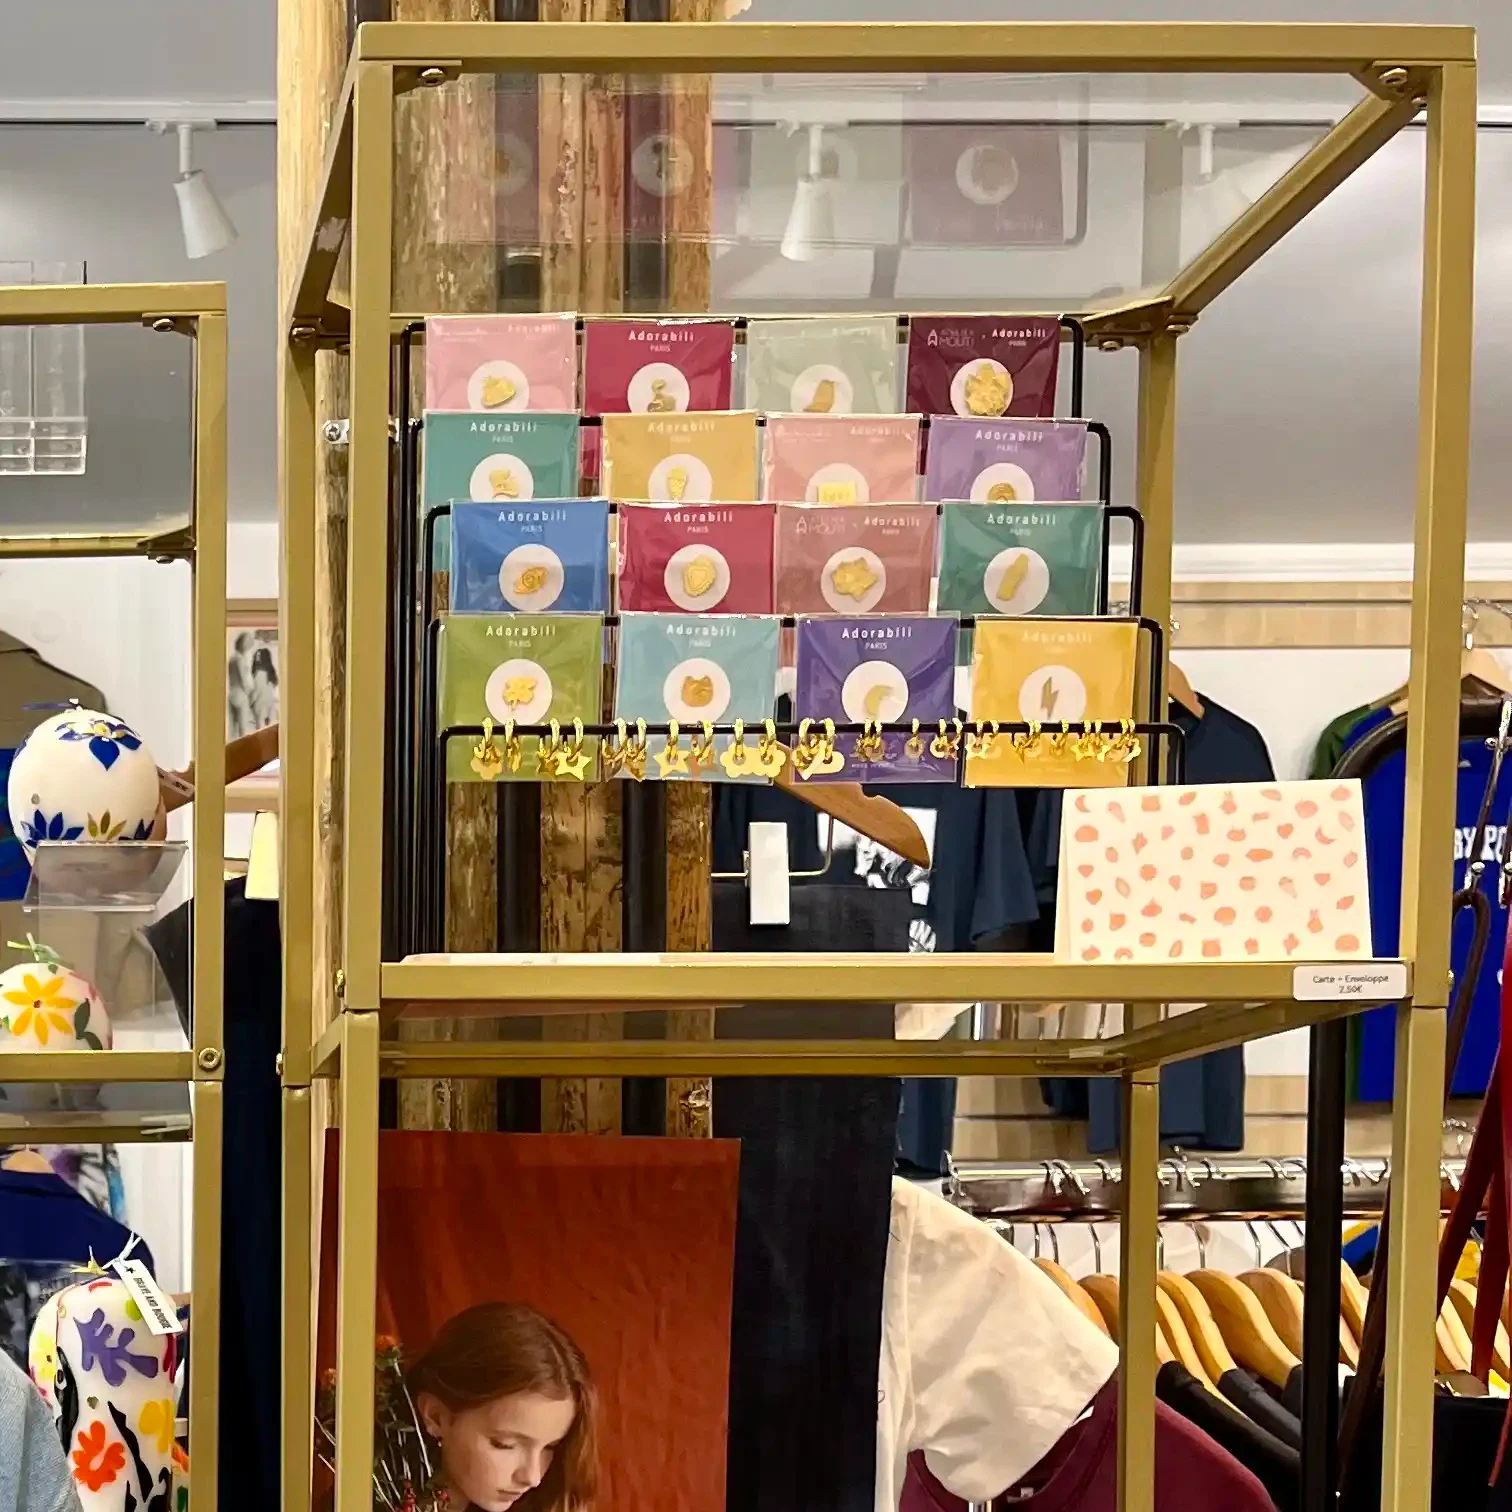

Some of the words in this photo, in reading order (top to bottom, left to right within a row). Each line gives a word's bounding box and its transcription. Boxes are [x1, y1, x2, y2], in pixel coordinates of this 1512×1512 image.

[628, 330, 694, 342] Adorabili
[992, 328, 1046, 338] Adorabili
[470, 420, 538, 433] Adorabili
[647, 420, 716, 433] Adorabili
[975, 429, 1044, 443] Adorabili
[498, 510, 567, 523] Adorabili
[664, 510, 734, 523] Adorabili
[987, 513, 1057, 526] Adorabili
[486, 625, 556, 637] Adorabili
[666, 624, 736, 637] Adorabili
[842, 626, 912, 639] Adorabili
[1312, 975, 1335, 983] Carte
[1344, 975, 1389, 984] Enveloppe
[1339, 985, 1363, 994] 2.50€
[145, 1295, 159, 1307] AND
